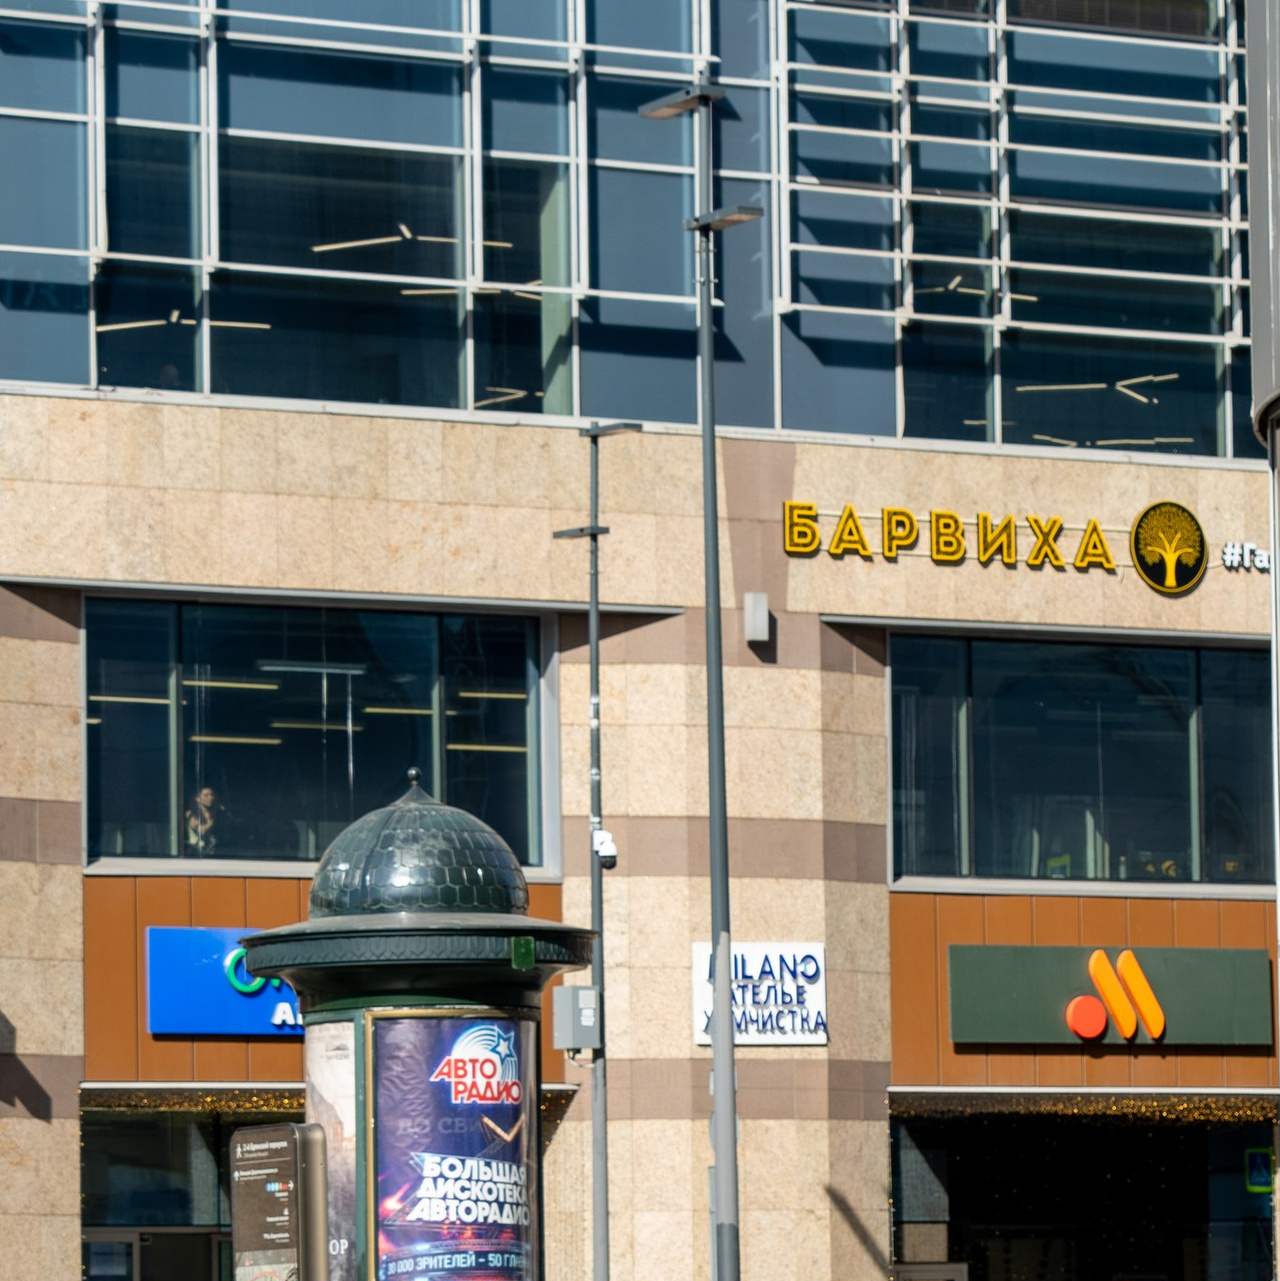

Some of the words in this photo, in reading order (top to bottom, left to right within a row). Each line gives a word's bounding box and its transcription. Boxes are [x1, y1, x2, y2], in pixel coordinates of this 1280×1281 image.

[783, 501, 1117, 570] БАРВИХА
[709, 954, 820, 982] ILANO
[433, 1058, 497, 1080] АВТО
[454, 1080, 523, 1103] РАДИО
[422, 1156, 526, 1185] БОЛЬШАЯ
[416, 1177, 529, 1205] ДИСКОТЕКА
[406, 1197, 531, 1226] АВТОРАДИО
[416, 1251, 476, 1270] ЗРИТЕЛЕЙ
[488, 1253, 502, 1267] 50
